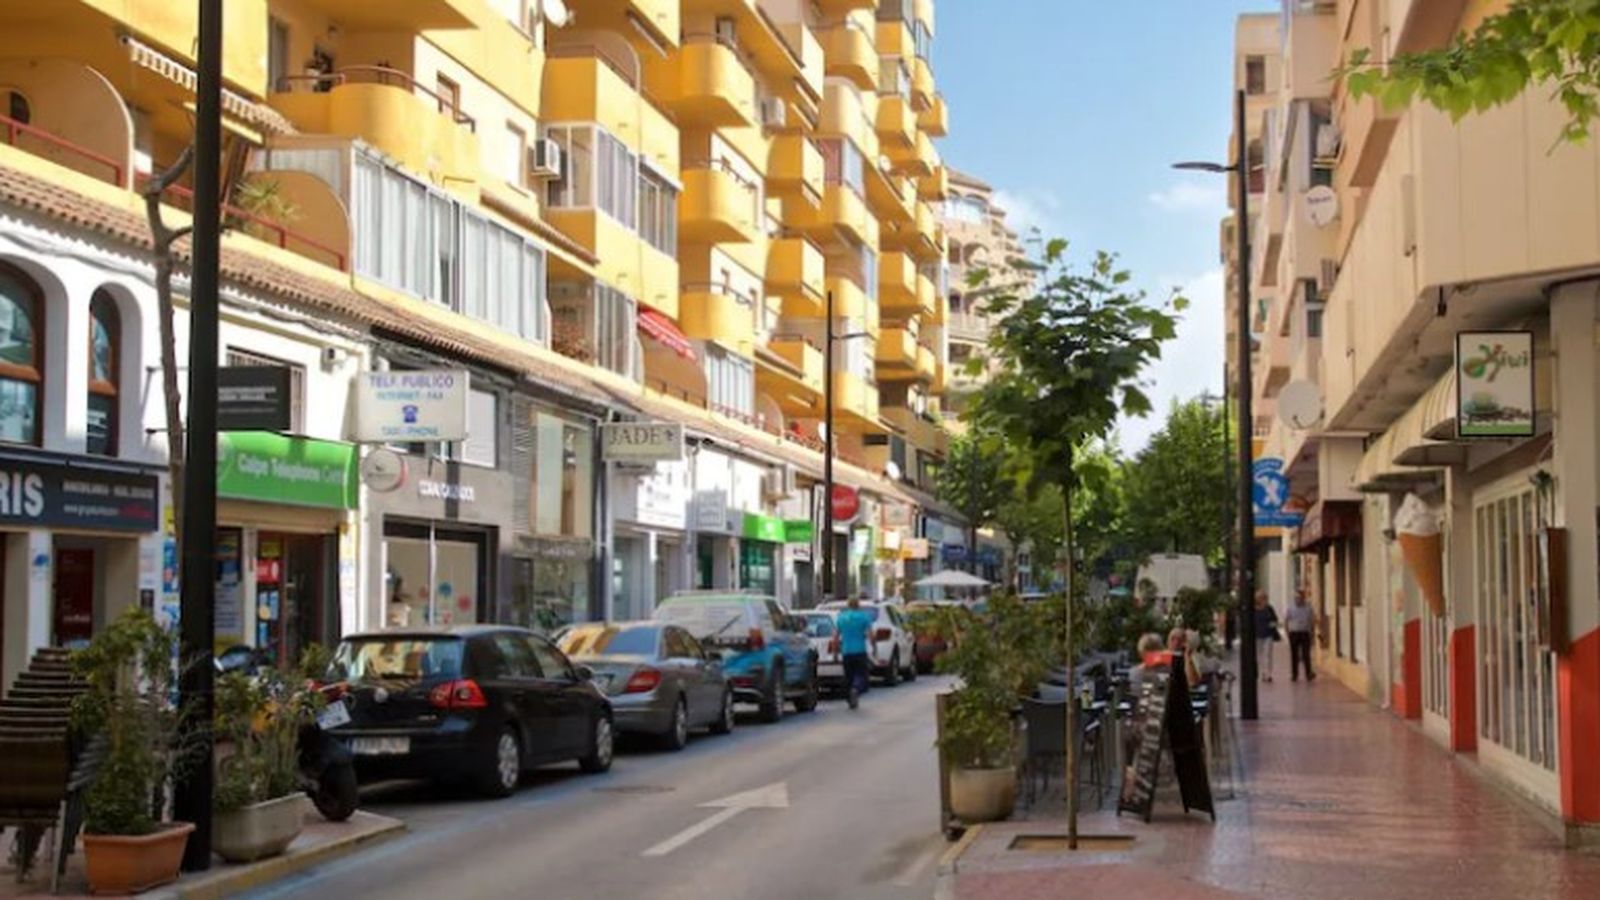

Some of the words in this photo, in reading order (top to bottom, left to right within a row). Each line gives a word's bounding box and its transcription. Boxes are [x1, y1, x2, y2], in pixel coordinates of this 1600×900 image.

[608, 425, 661, 446] JADE
[238, 452, 269, 478] Calpe
[271, 458, 320, 482] Telephone
